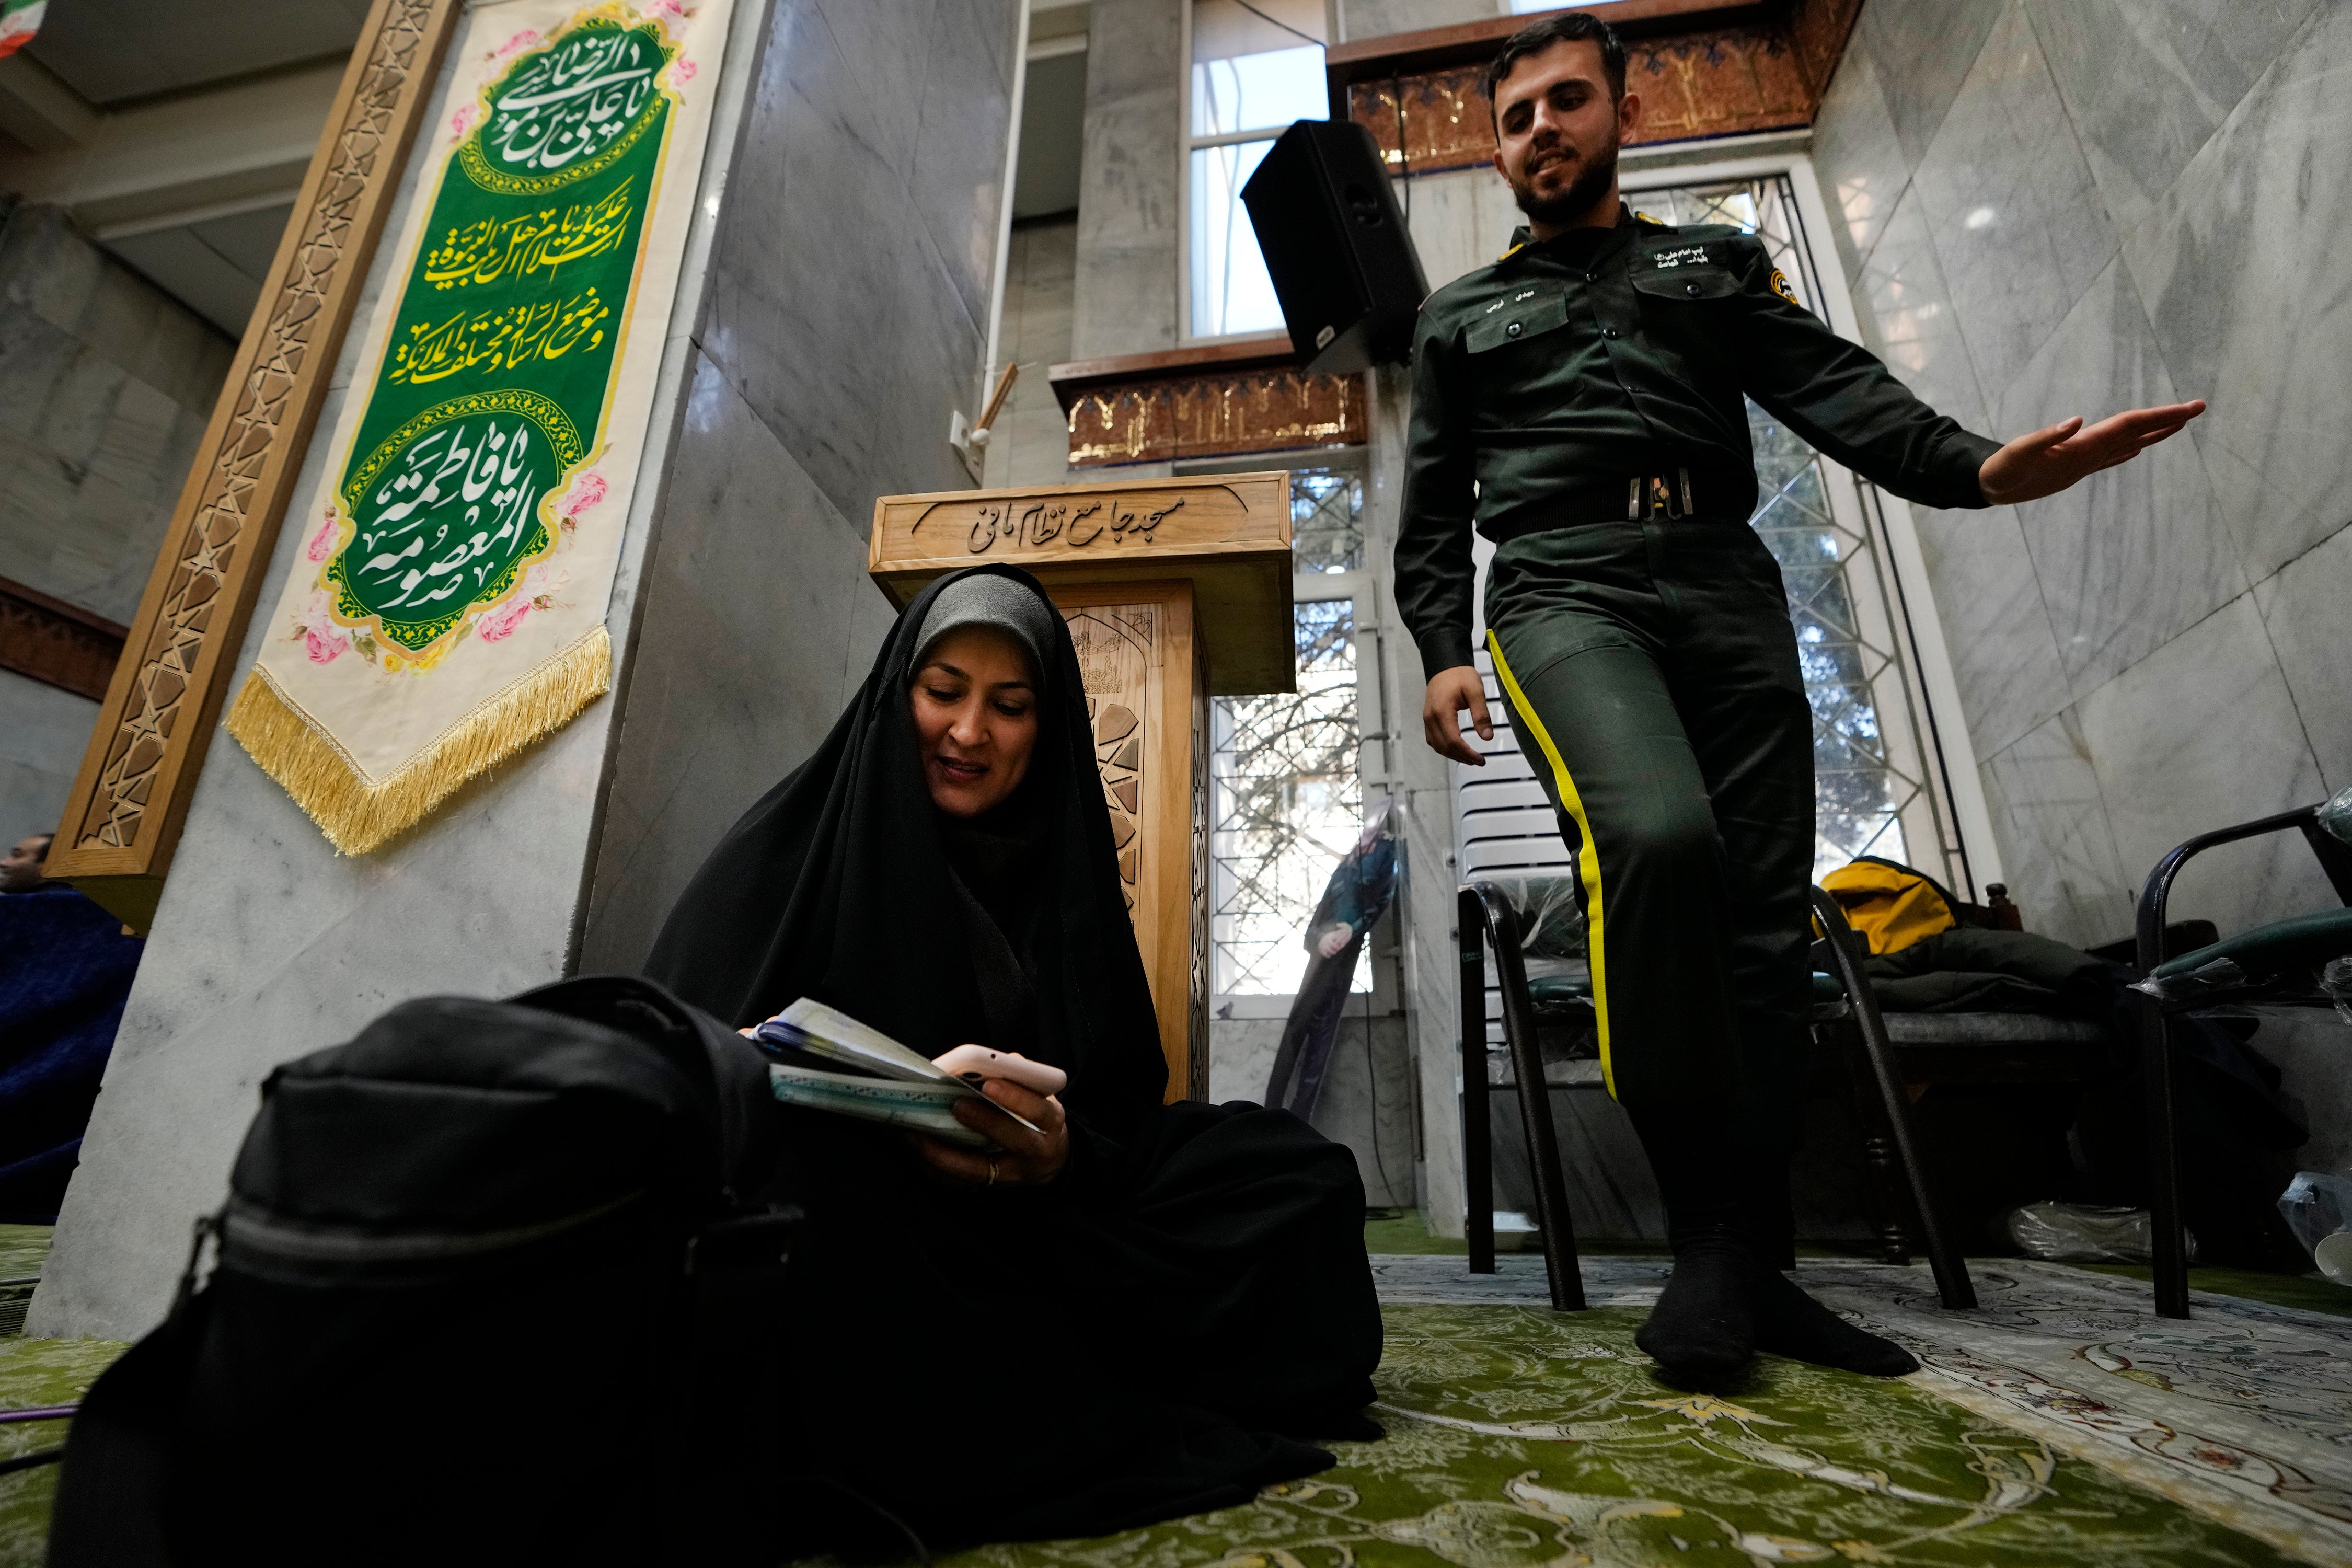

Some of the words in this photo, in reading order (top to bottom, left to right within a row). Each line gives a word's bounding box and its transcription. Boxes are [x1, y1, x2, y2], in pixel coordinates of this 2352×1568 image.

[1018, 500, 1066, 547] نظام
[1066, 500, 1134, 547] جامع
[1128, 496, 1185, 543] مسجد
